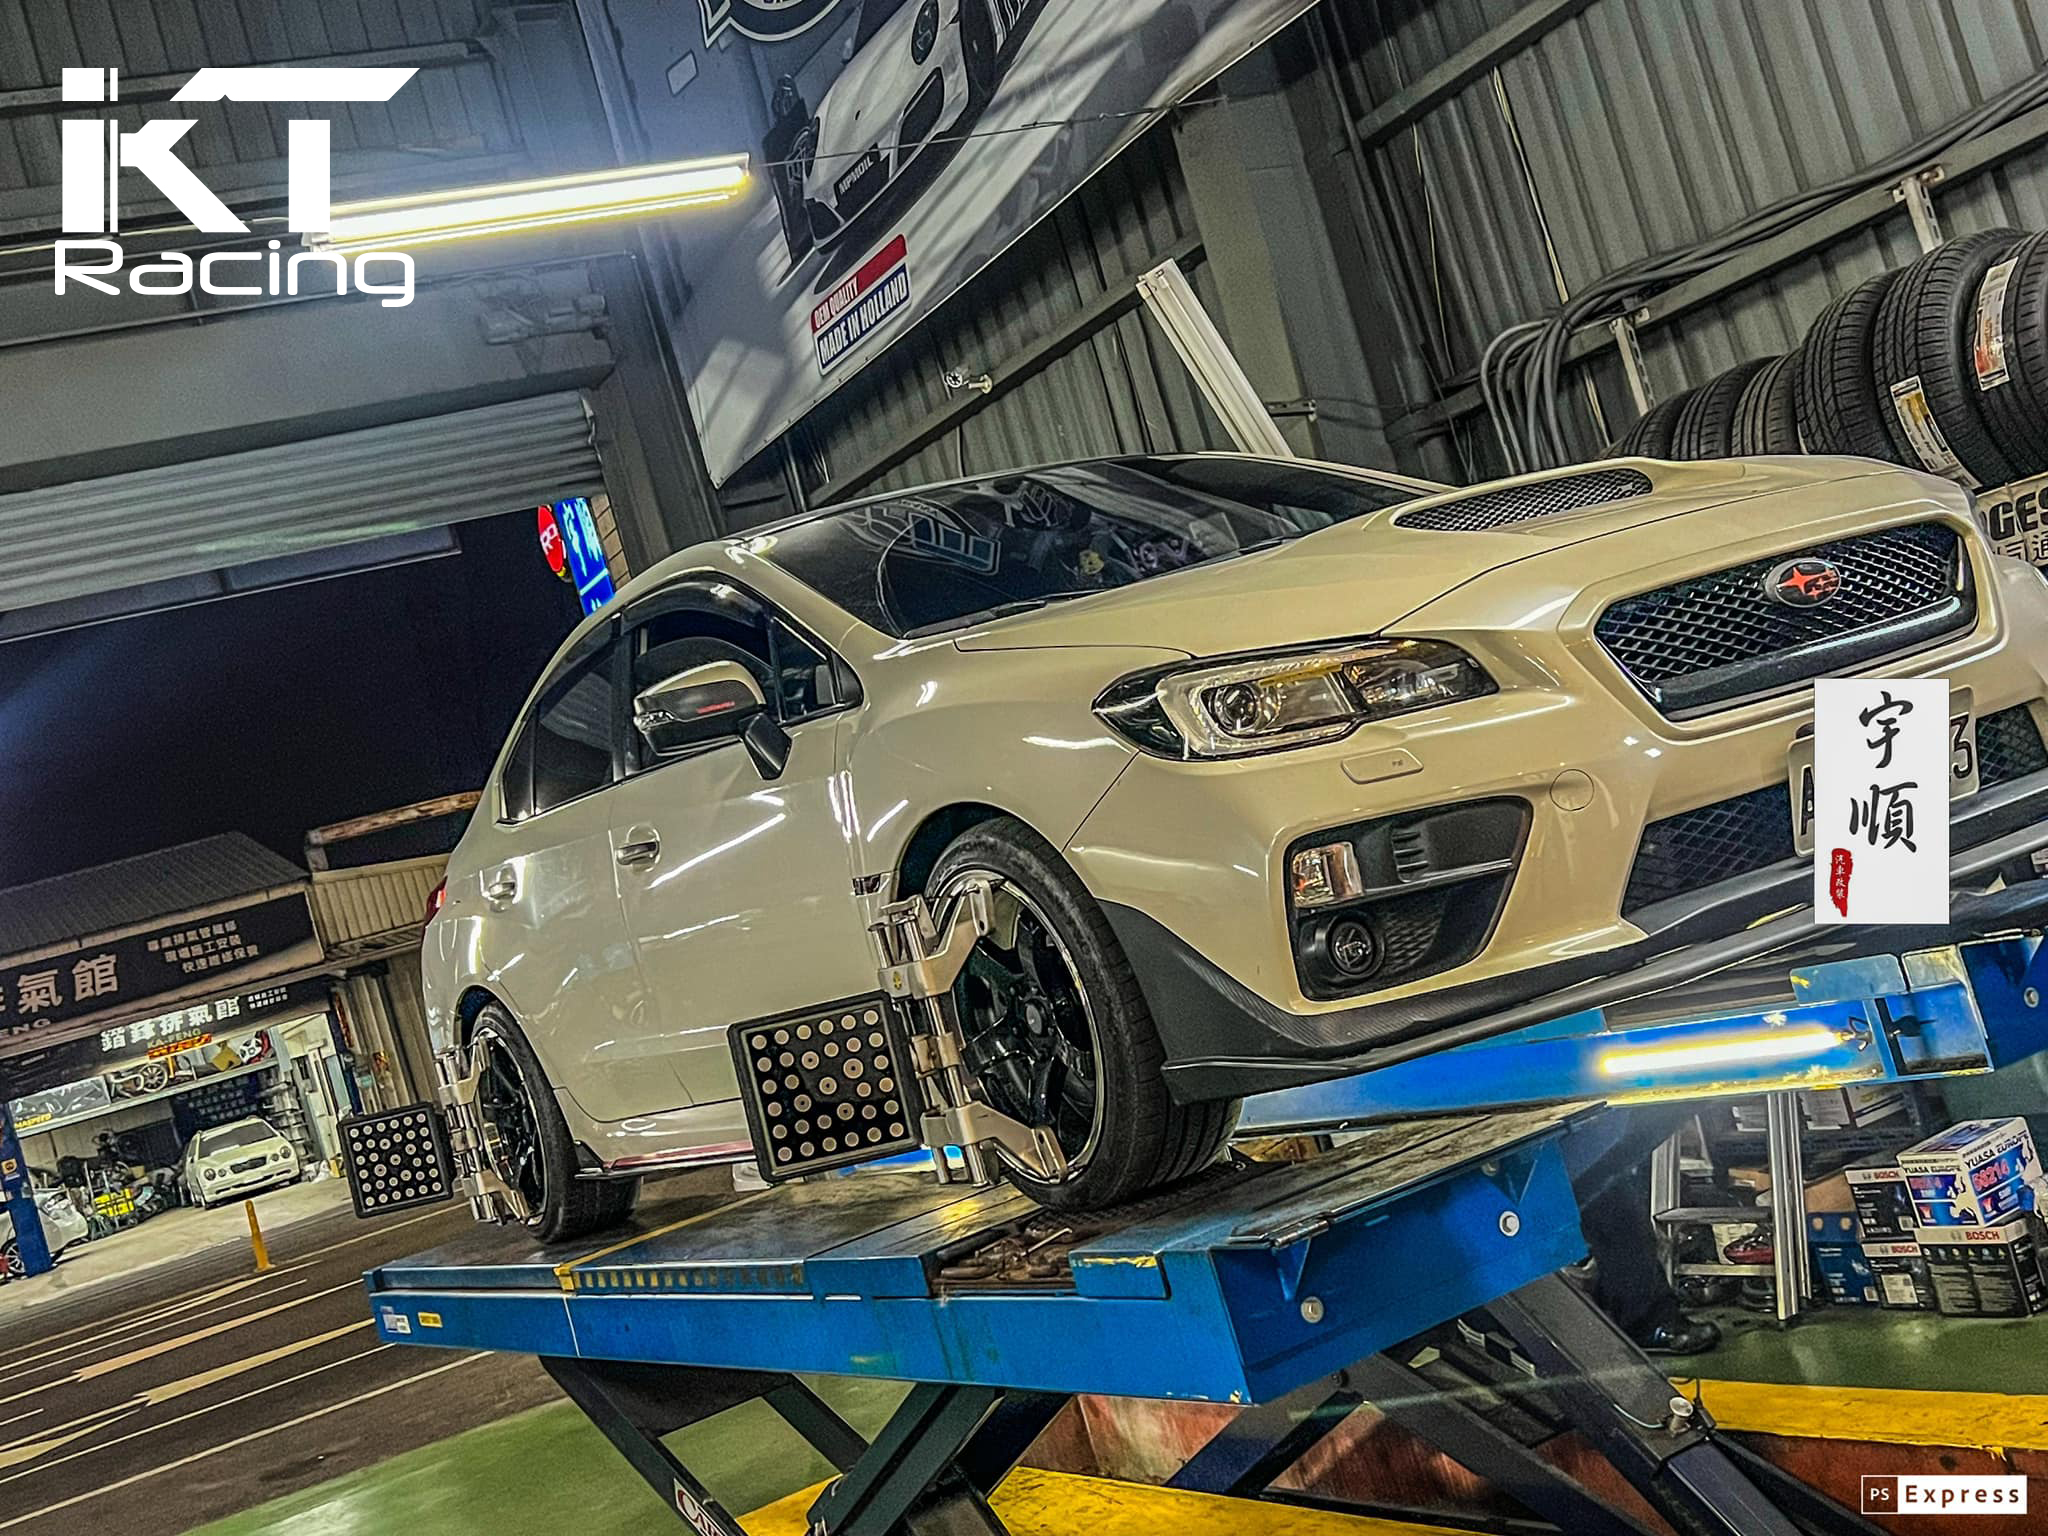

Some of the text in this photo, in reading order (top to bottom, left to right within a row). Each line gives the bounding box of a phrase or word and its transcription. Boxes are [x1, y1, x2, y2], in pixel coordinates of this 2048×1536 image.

[839, 154, 874, 195] MPMOIL
[813, 275, 859, 329] OEM QUALITY
[819, 271, 908, 365] MADE IN HOLLAND
[0, 953, 119, 1015] 氣館
[1964, 1148, 1996, 1169] YUASA
[1996, 1130, 2029, 1154] EUROPE
[1891, 1244, 1918, 1253] BOSCH
[1965, 1231, 2000, 1241] BOSCH
